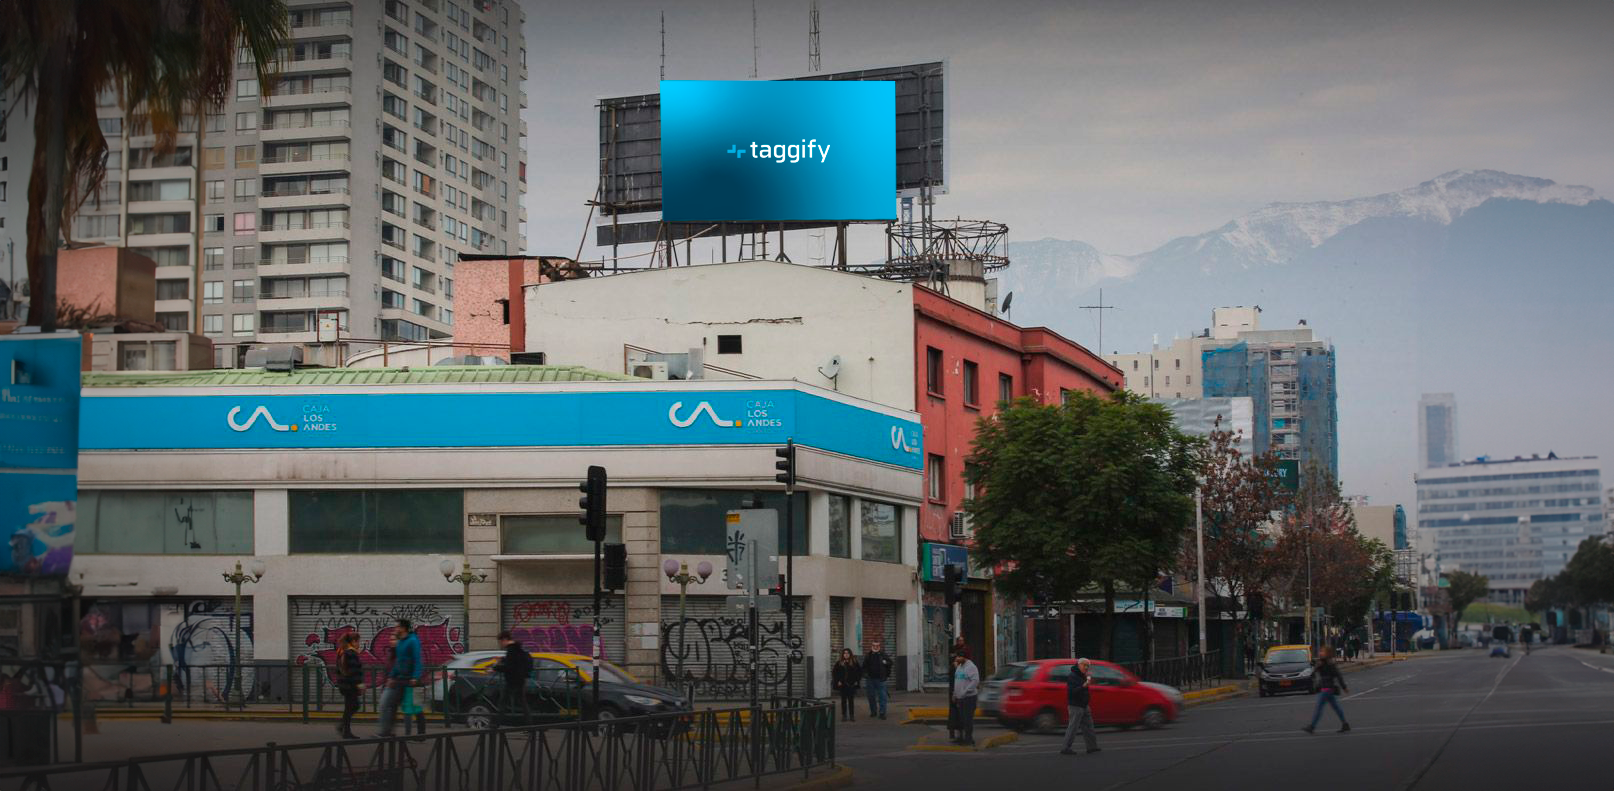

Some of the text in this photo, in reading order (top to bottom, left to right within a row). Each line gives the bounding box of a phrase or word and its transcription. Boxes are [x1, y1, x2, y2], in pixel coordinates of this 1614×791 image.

[750, 138, 831, 164] taggify
[302, 404, 330, 413] CAJA
[747, 400, 774, 409] CAJA
[303, 414, 323, 422] LOS
[747, 409, 768, 418] LOS
[303, 423, 337, 431] ANDES
[747, 418, 782, 427] ANDES
